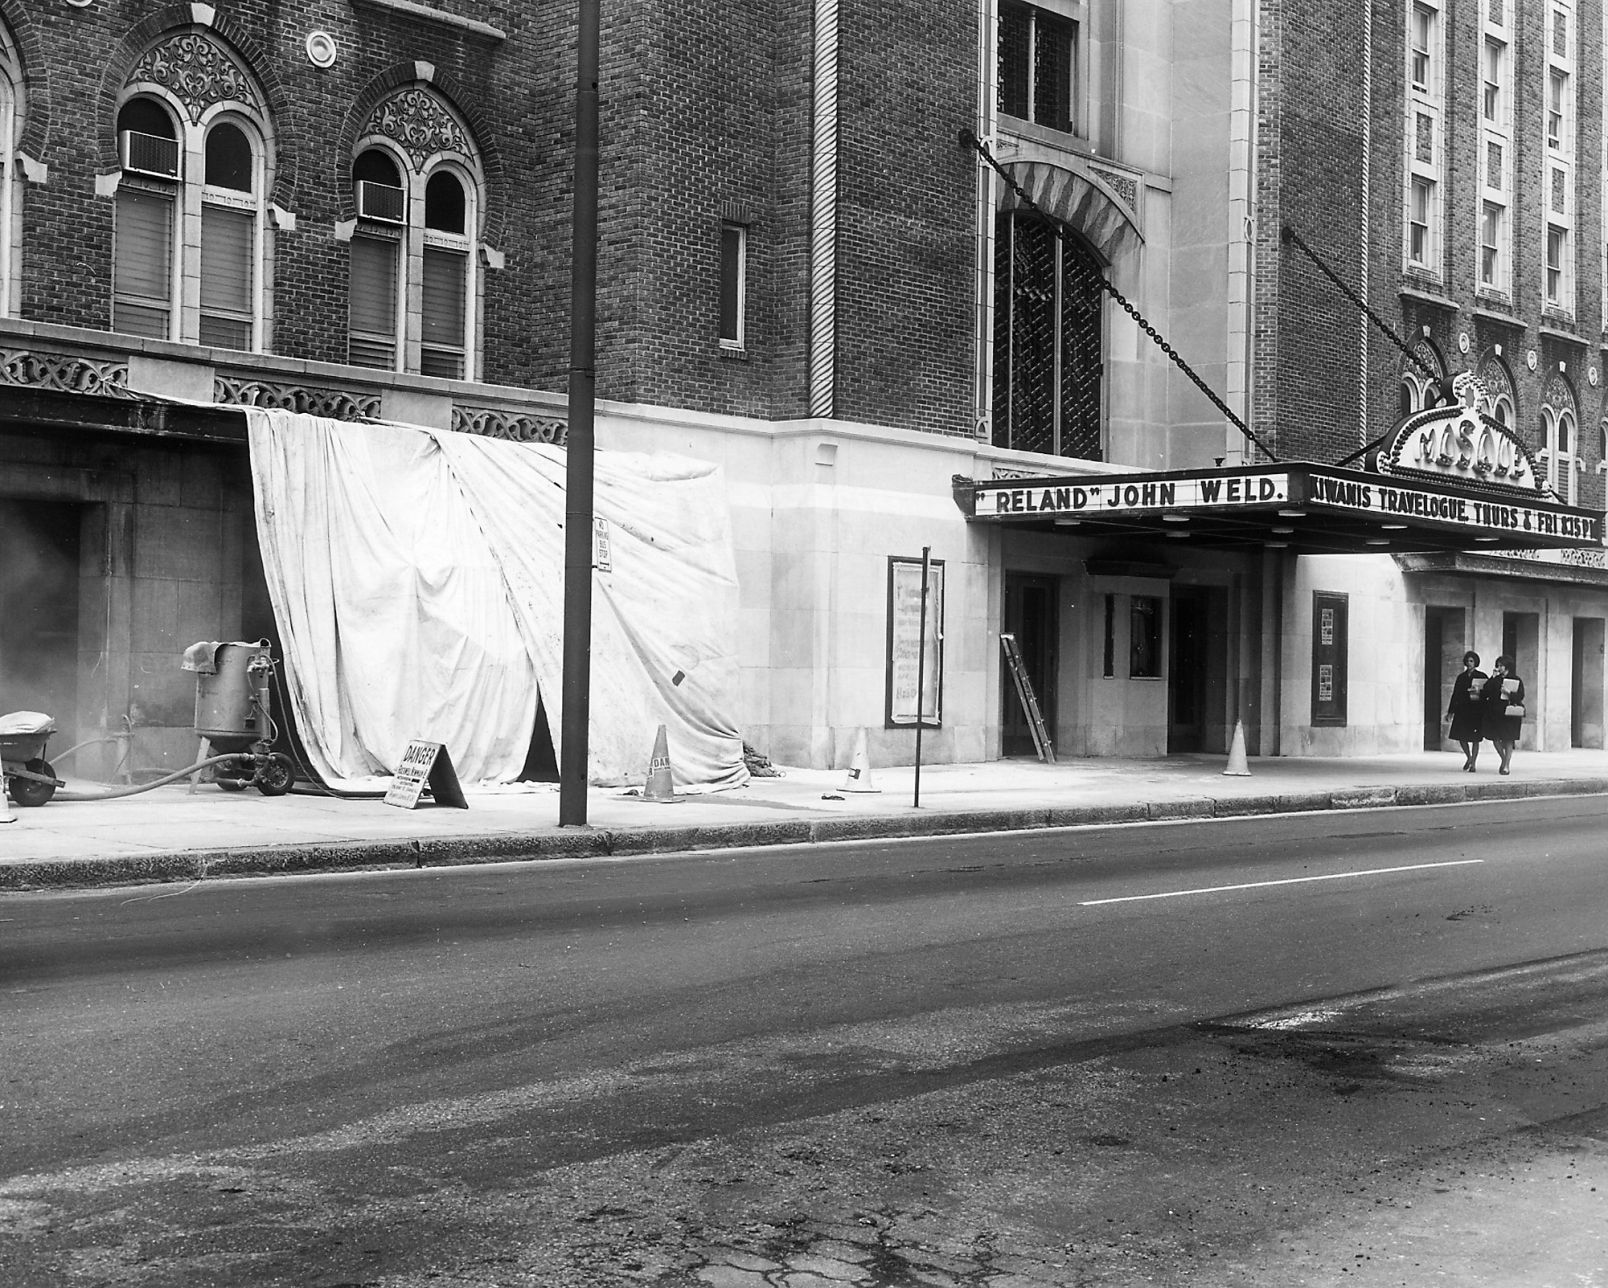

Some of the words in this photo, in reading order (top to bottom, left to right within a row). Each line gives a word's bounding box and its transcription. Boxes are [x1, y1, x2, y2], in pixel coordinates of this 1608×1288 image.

[1414, 420, 1525, 479] MOSQUE
[1108, 483, 1175, 508] JOHN
[1201, 477, 1284, 503] WELD.
[1311, 476, 1371, 508] KIWANIS
[1379, 487, 1469, 522] TRAVELOGUE.
[1474, 502, 1518, 529] THURS
[1523, 510, 1532, 531] &
[1538, 512, 1557, 534] FRI
[403, 745, 436, 766] DANGER
